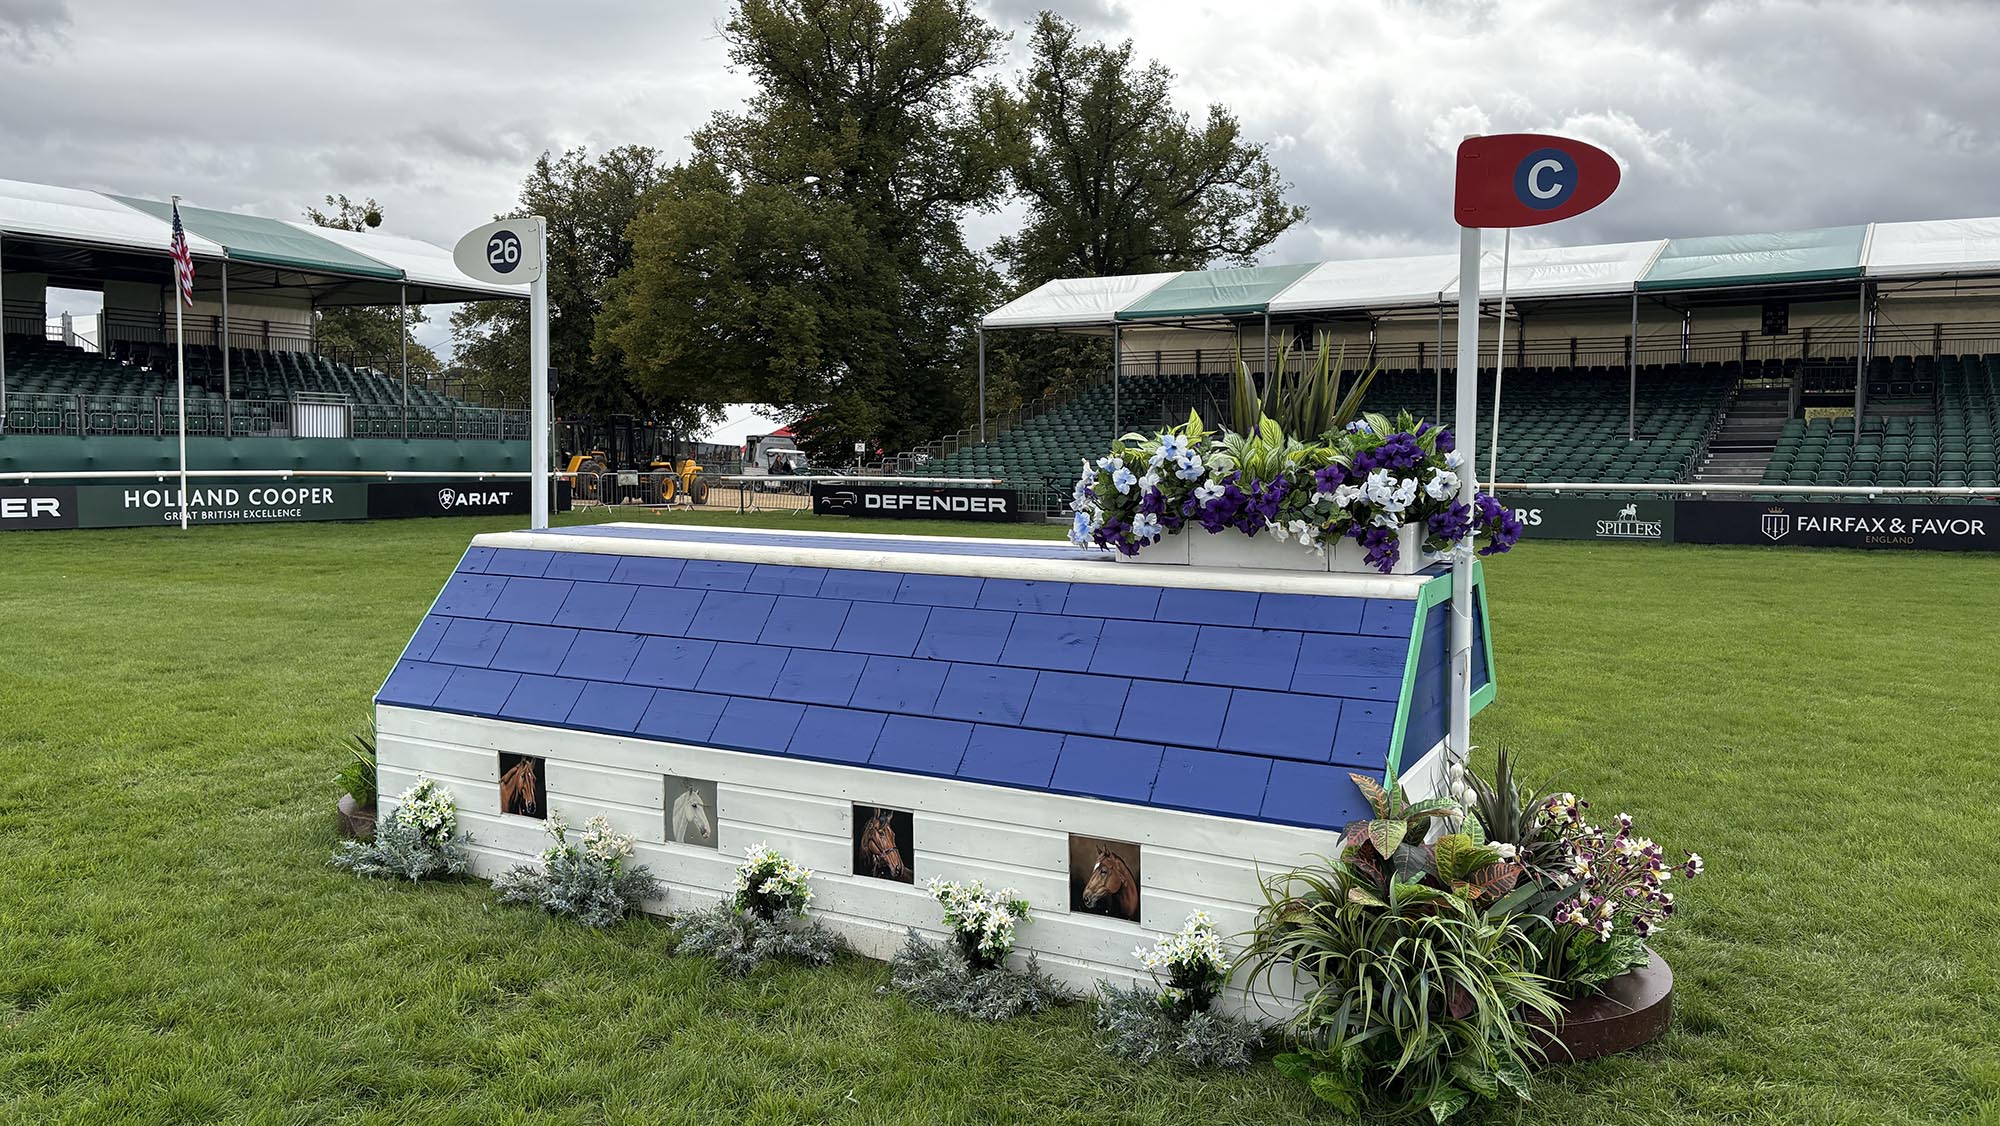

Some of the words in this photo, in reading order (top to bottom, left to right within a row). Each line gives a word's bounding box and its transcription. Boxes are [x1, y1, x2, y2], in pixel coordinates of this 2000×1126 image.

[1527, 158, 1564, 199] C
[489, 238, 518, 264] 26
[124, 489, 240, 508] HOLLAND
[248, 488, 334, 505] COOPER
[455, 492, 511, 507] ARIAT
[865, 494, 1007, 513] DEFENDER
[201, 509, 240, 520] BRITISH
[243, 508, 302, 519] EXCELLENCE
[1596, 519, 1662, 537] SPILLERS
[1797, 516, 1886, 534] FAIRFAX
[1889, 518, 1906, 534] &
[1911, 518, 1986, 536] FAVOR
[1865, 535, 1914, 545] ENGLAND
